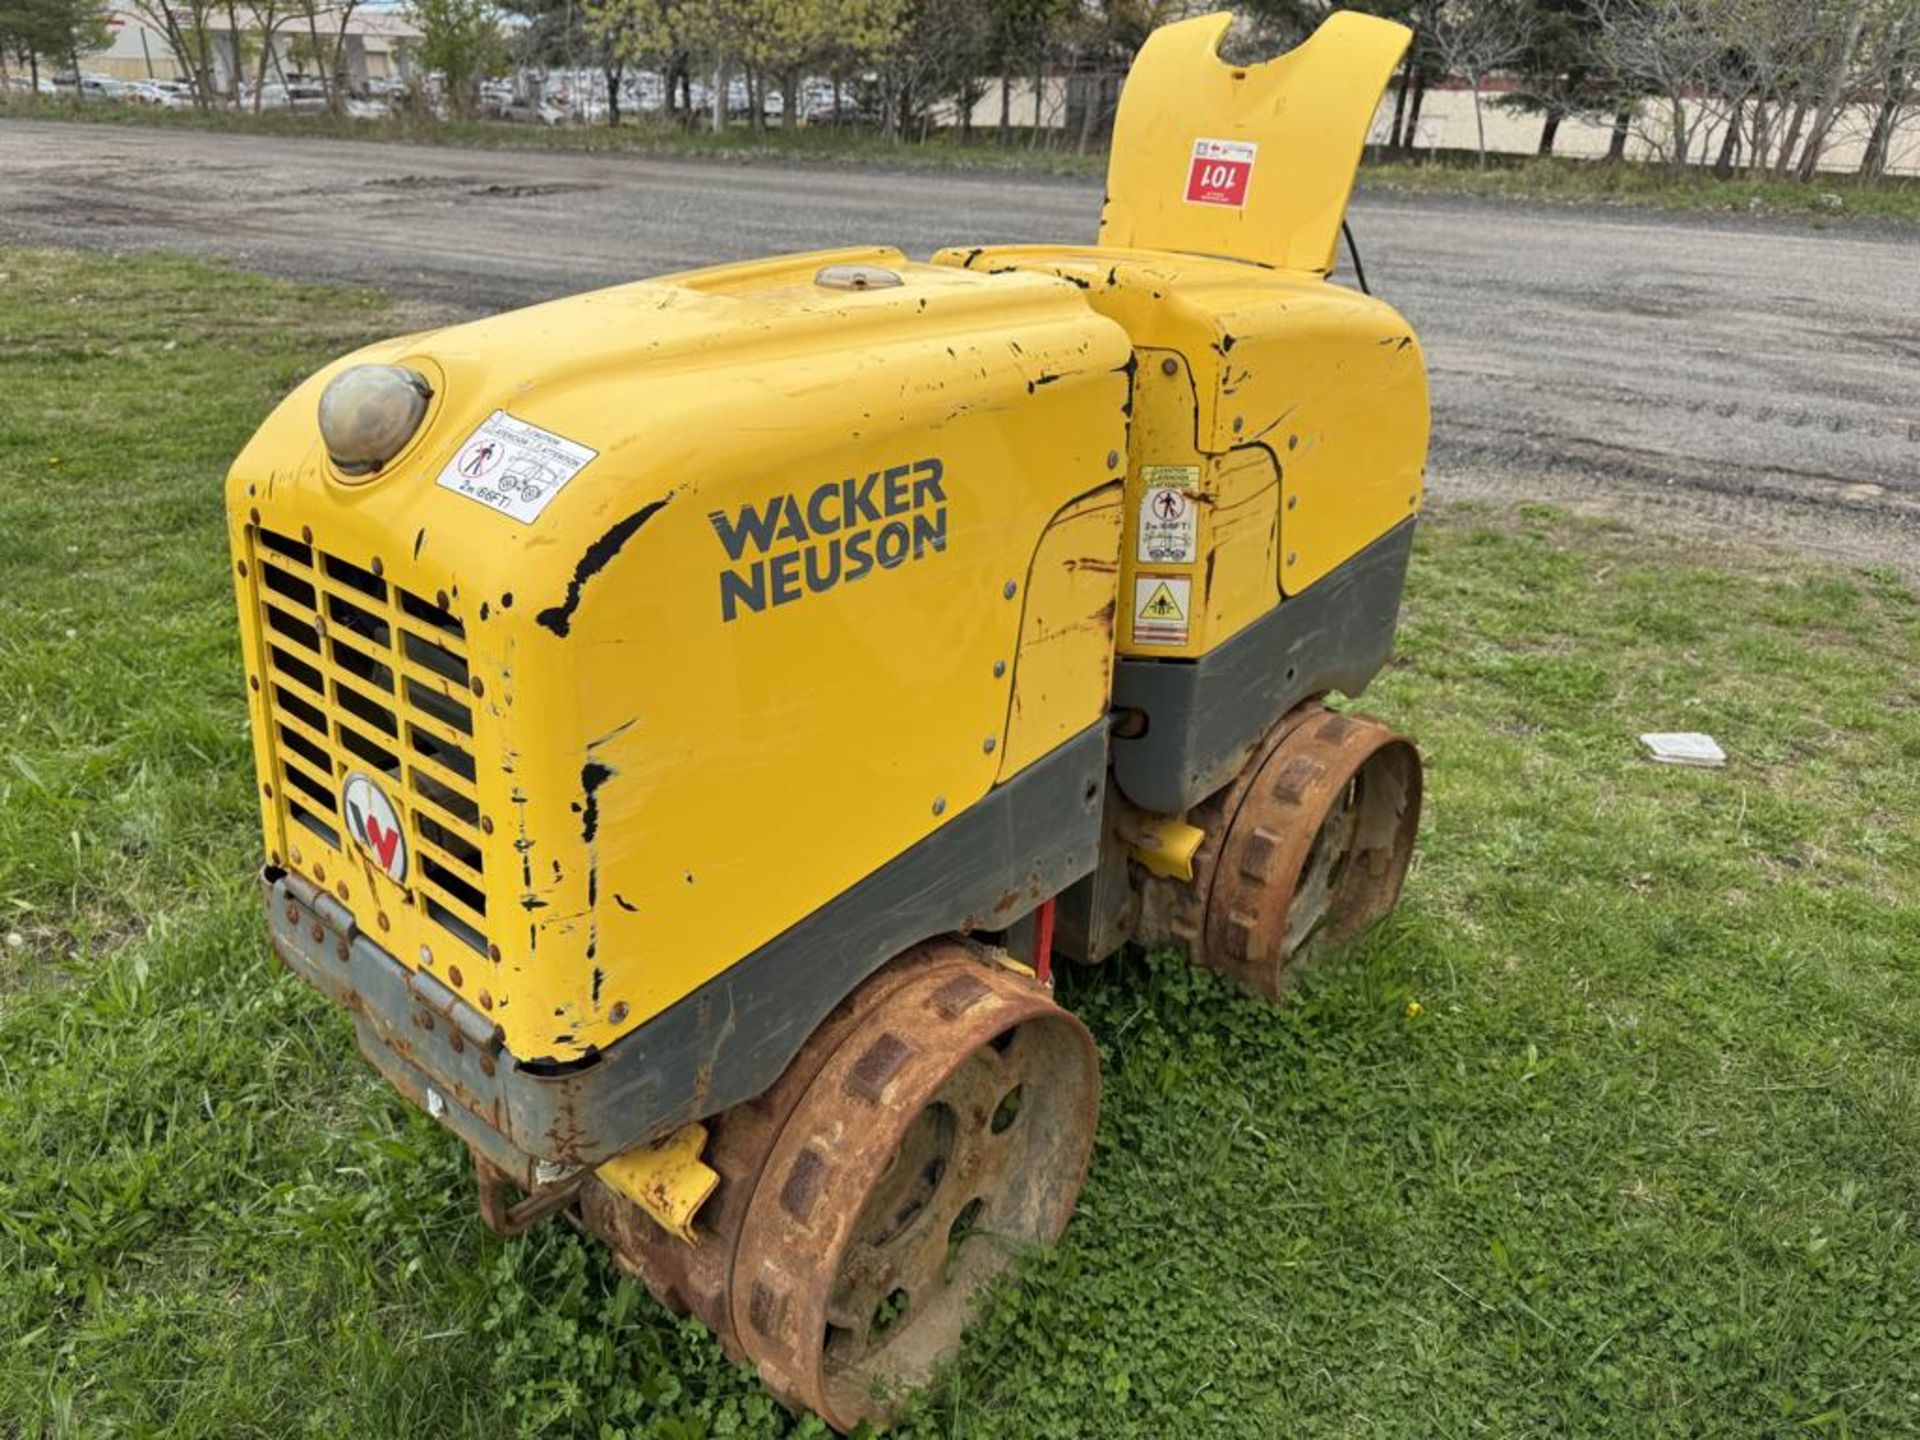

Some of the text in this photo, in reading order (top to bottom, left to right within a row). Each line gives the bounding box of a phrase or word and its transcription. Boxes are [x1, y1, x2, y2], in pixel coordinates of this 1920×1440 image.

[1200, 165, 1236, 189] 101
[708, 458, 947, 560] WACKER
[720, 507, 947, 622] NEUSON
